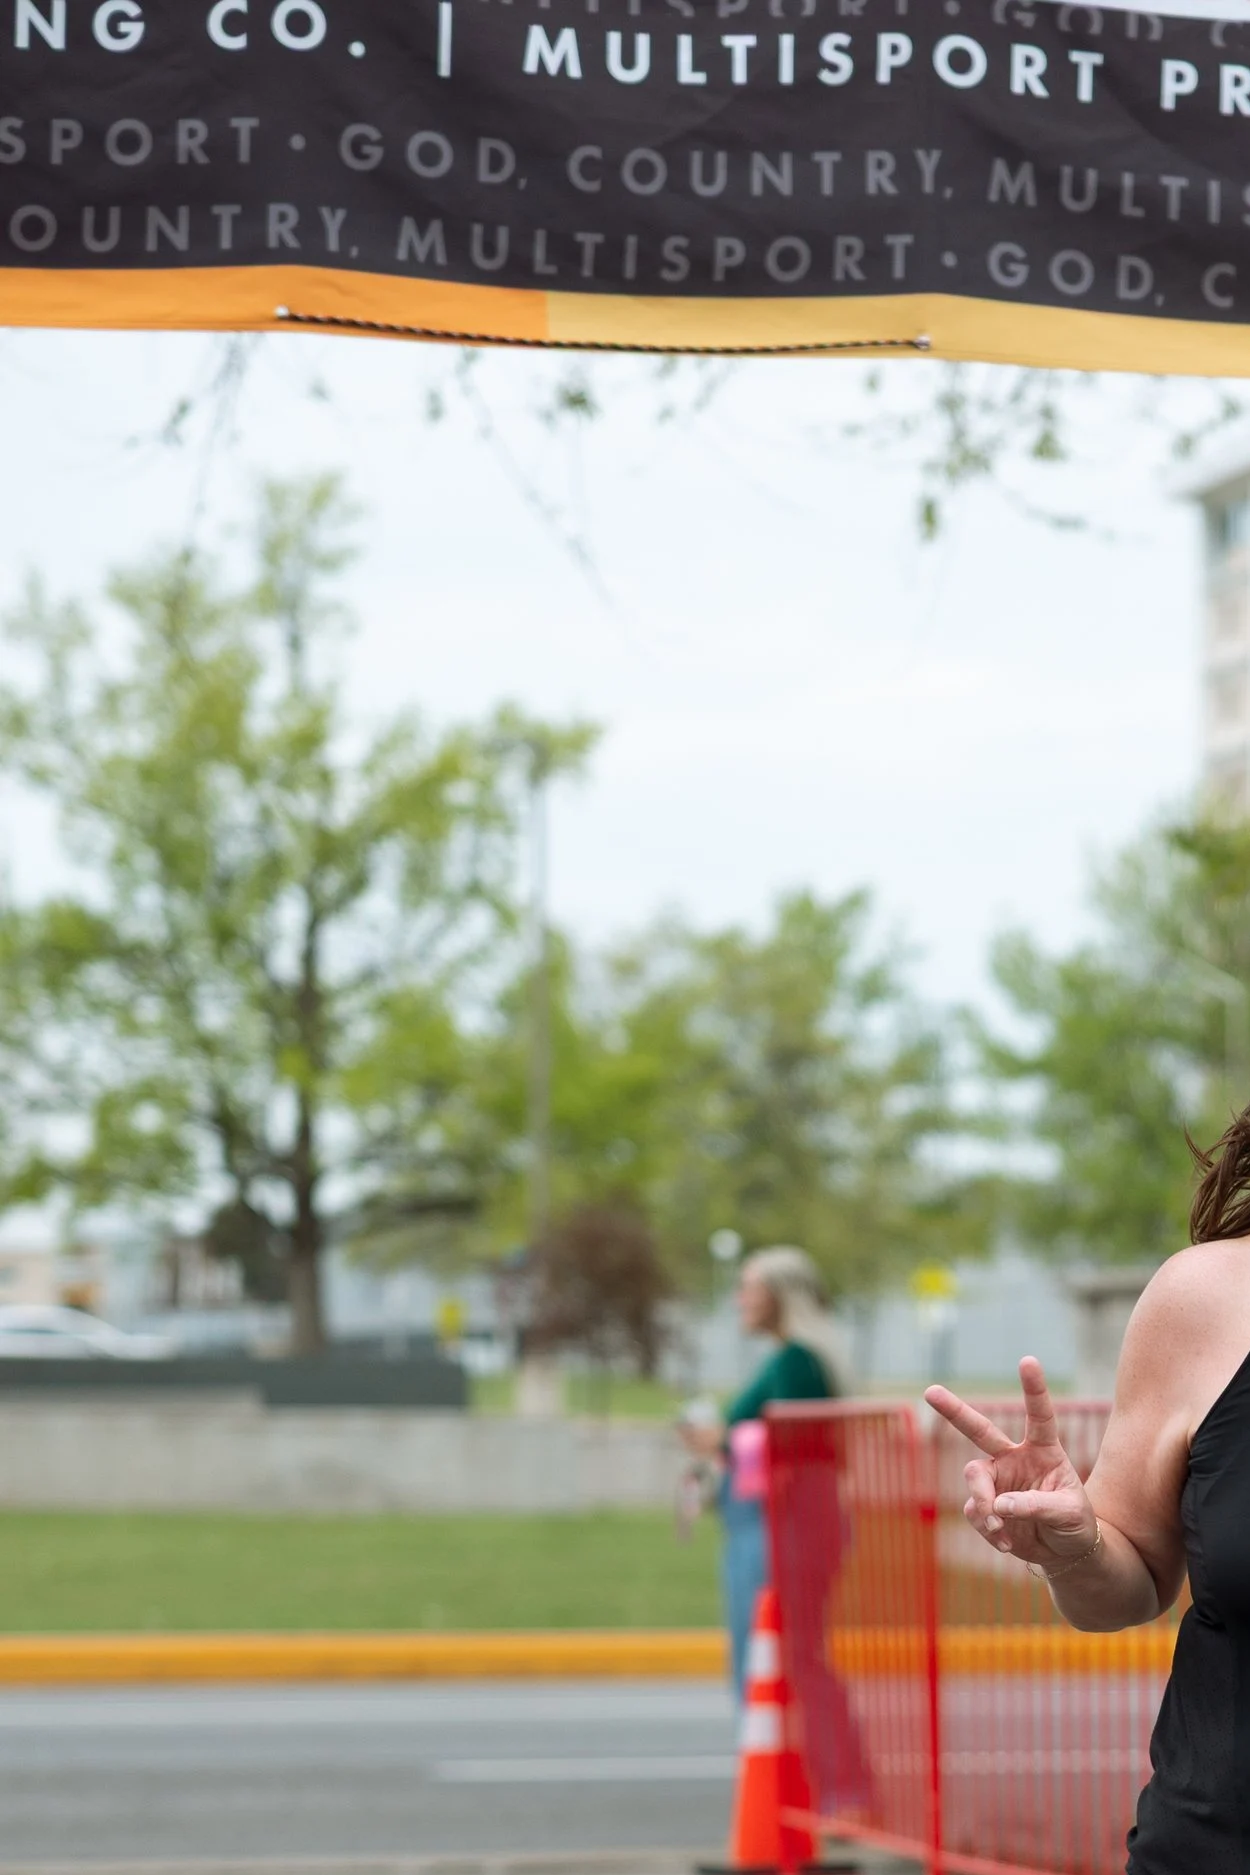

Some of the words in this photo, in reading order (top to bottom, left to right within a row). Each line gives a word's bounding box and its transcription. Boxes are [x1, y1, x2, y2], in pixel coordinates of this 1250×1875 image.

[206, 0, 367, 58] CO.
[522, 24, 1105, 105] MULTISPORT
[0, 117, 260, 166] SPORT
[395, 216, 915, 282] MULTISPORT
